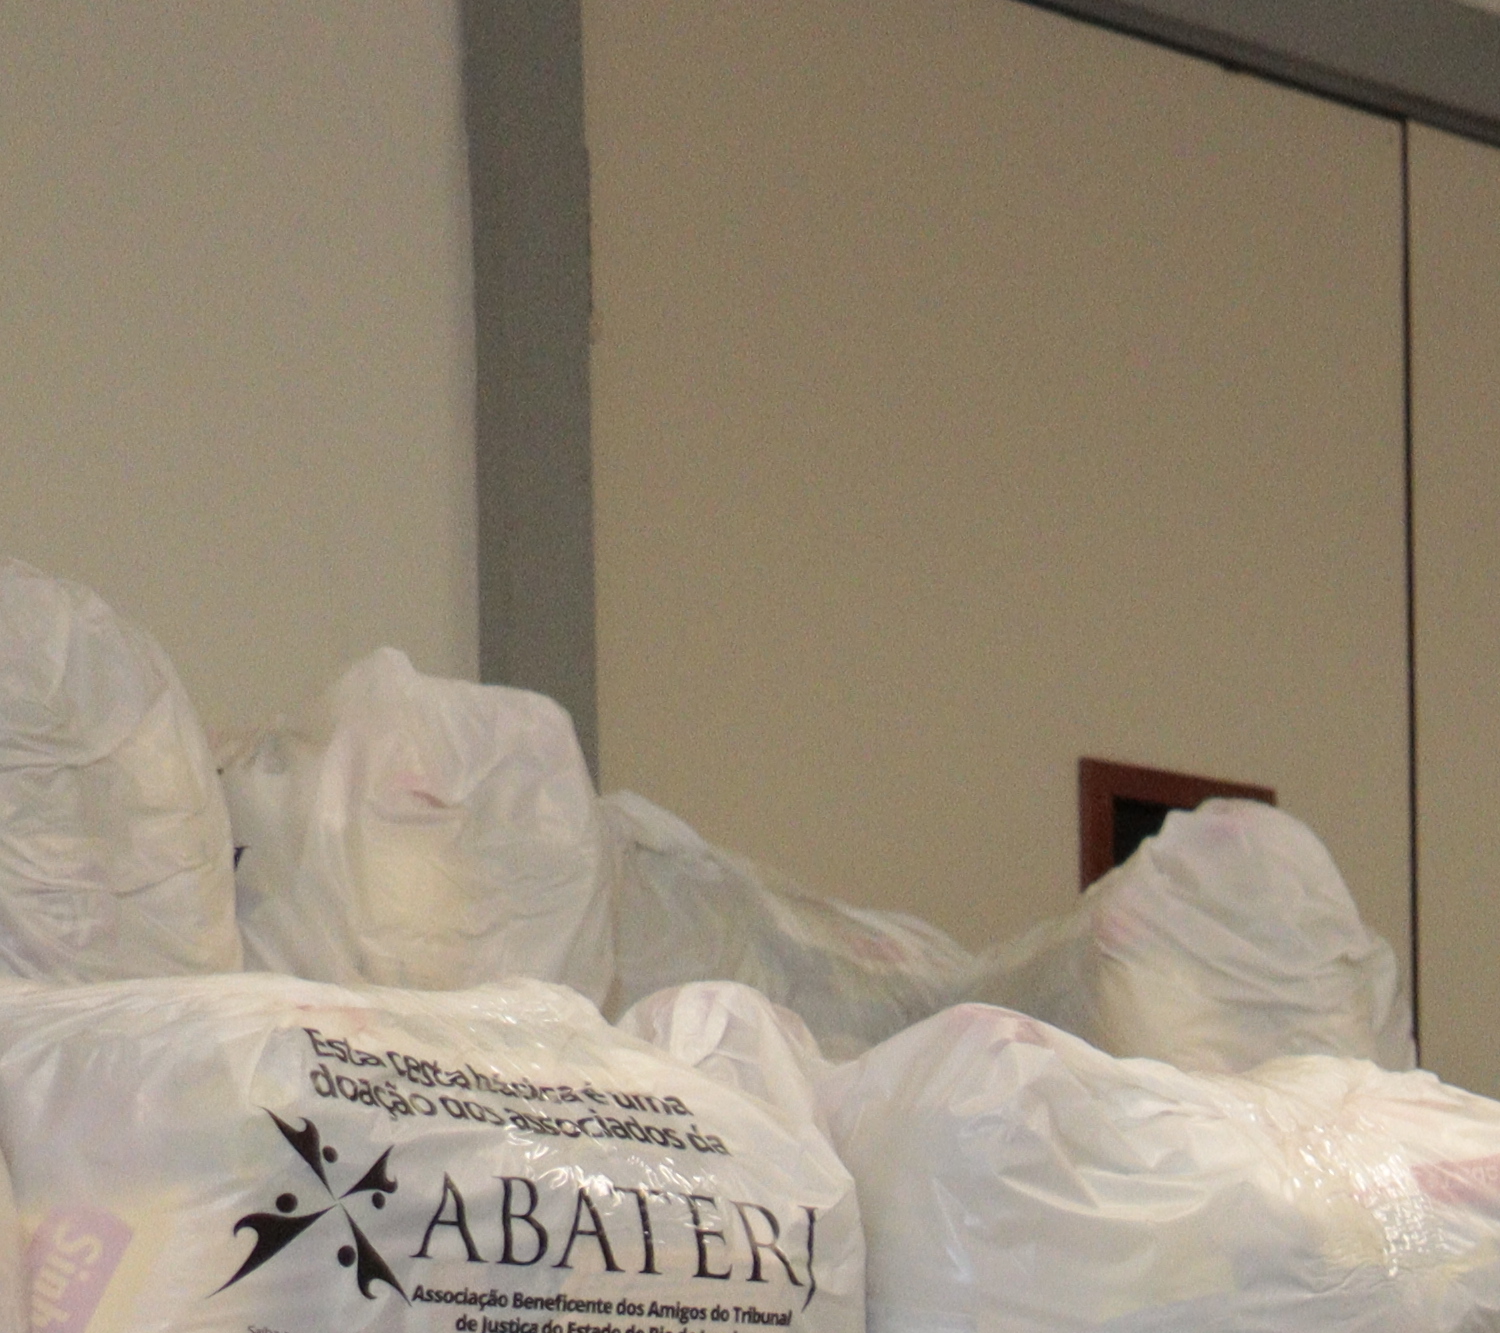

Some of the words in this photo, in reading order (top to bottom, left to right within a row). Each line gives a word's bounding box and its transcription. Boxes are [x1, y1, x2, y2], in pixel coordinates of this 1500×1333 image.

[304, 1028, 386, 1069] Esta
[609, 1092, 694, 1117] uma
[310, 1064, 438, 1121] doação
[503, 1107, 686, 1151] associados
[688, 1125, 731, 1156] da
[409, 1172, 818, 1312] ABATERJ
[412, 1285, 508, 1310] Associação
[512, 1292, 612, 1315] Beneficente
[617, 1298, 644, 1317] dos
[648, 1301, 706, 1325] Amigos
[711, 1305, 730, 1322] do
[733, 1306, 792, 1327] Tribunal
[456, 1315, 477, 1333] de
